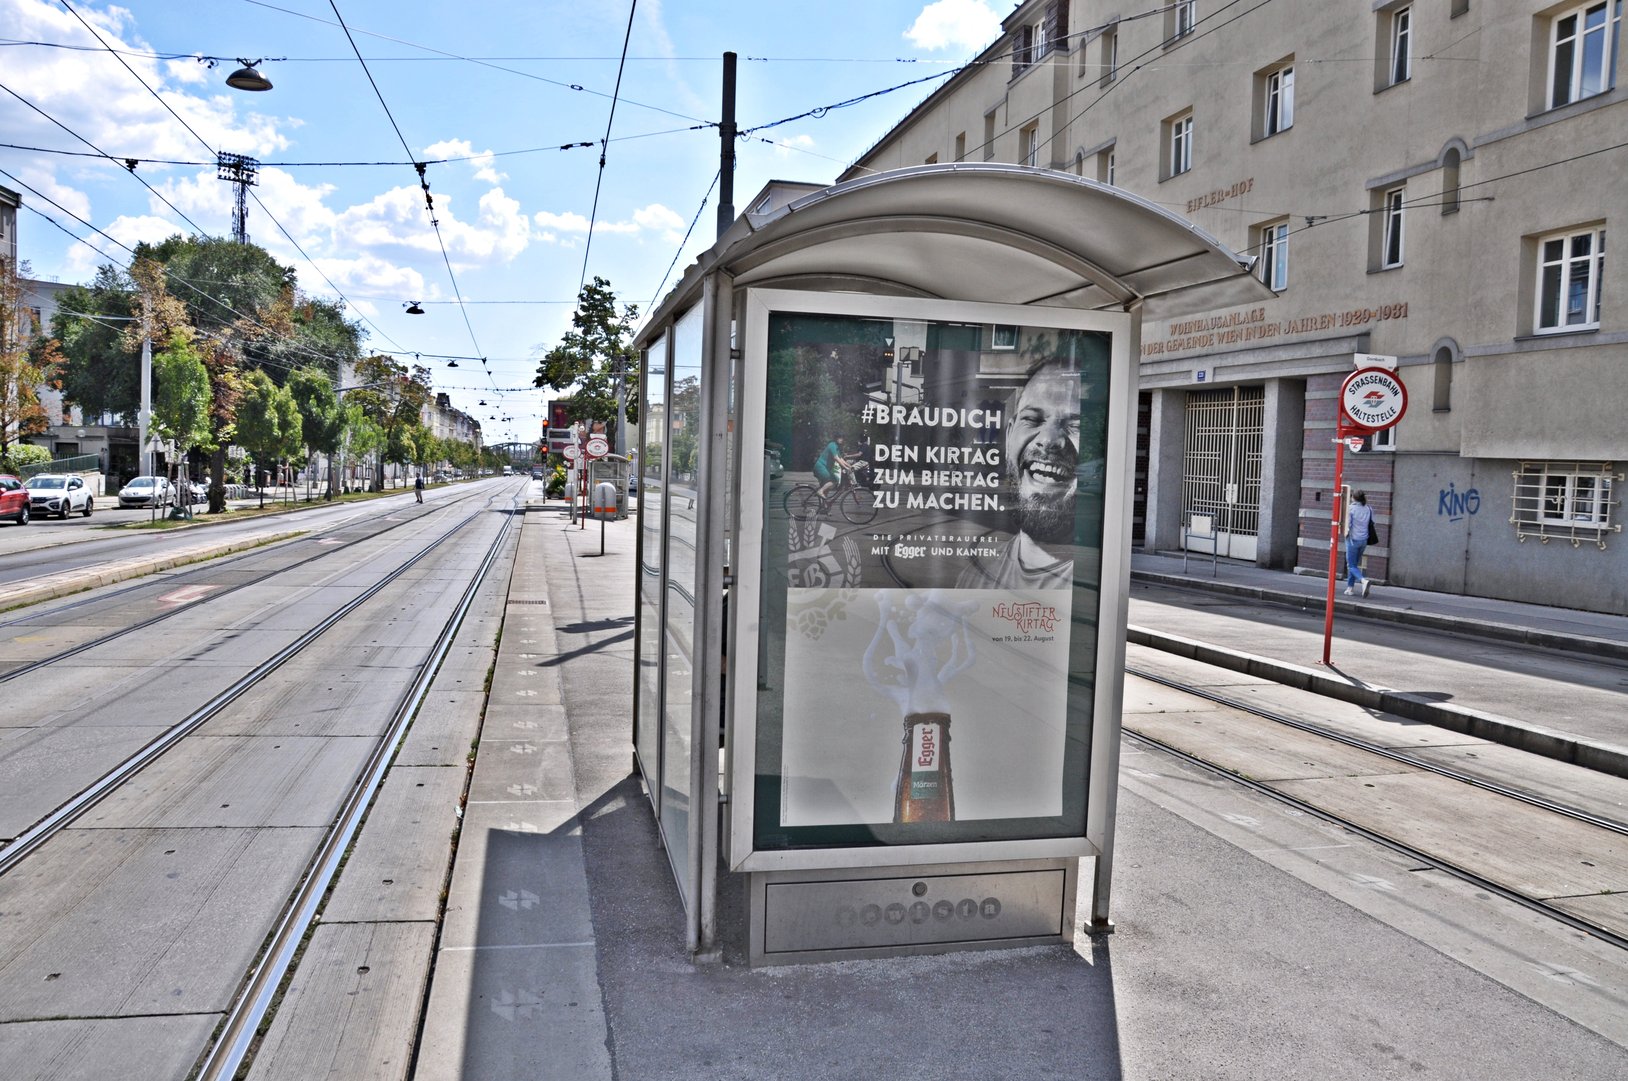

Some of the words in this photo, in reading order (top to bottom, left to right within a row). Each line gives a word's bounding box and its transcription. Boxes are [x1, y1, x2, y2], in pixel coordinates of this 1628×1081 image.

[1169, 307, 1266, 337] WOHNHAUSANLAGE
[1146, 341, 1165, 356] DER
[1166, 332, 1215, 353] GEMEINDE
[1215, 326, 1243, 346] WIEN
[1257, 321, 1282, 340] DEN
[1283, 311, 1337, 335] JAHREN
[1348, 375, 1401, 398] STRASSENBAHN
[861, 404, 1002, 430] #BRAUDICH
[1349, 404, 1397, 424] HALTESTELLE
[875, 444, 919, 463] DEN
[925, 445, 1000, 466] KIRTAG
[873, 468, 915, 485] ZUM
[921, 470, 999, 488] BIERTAG
[872, 491, 900, 509] ZU
[906, 491, 1005, 512] MACHEN.
[899, 534, 998, 543] PRIVATBRAUEREI
[871, 546, 890, 556] MIT
[894, 542, 927, 559] Egger
[930, 546, 954, 557] UND
[956, 546, 1001, 558] KANTEN.
[992, 602, 1062, 622] NEUSTIFTER
[1016, 618, 1055, 634] KIRTAG
[1033, 635, 1055, 644] August
[918, 727, 935, 767] Egger
